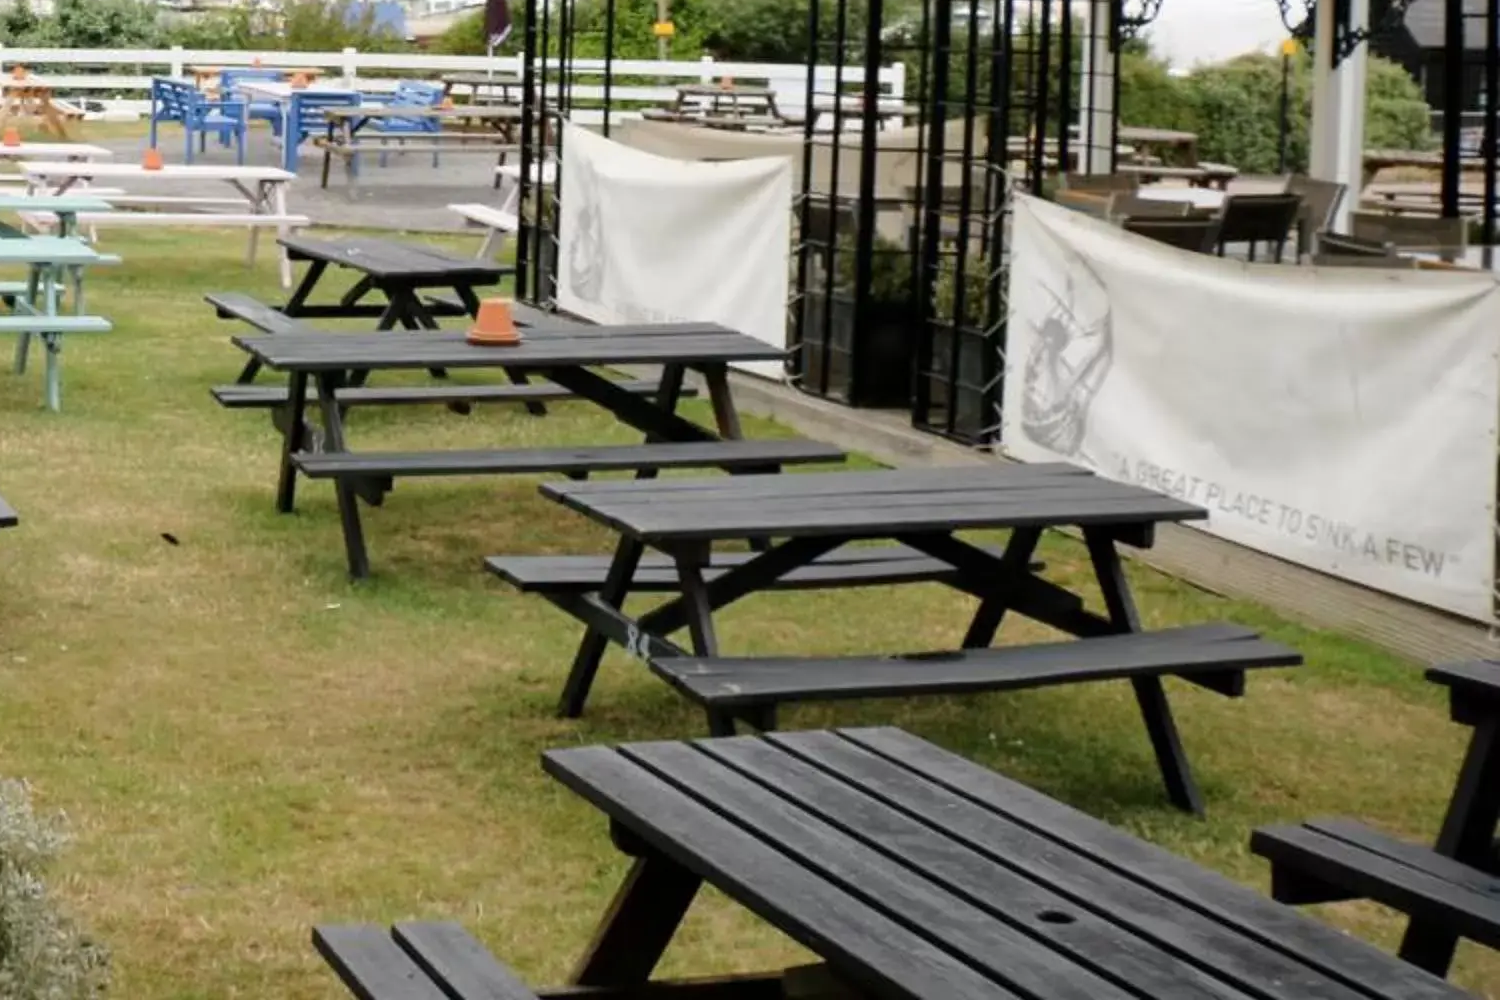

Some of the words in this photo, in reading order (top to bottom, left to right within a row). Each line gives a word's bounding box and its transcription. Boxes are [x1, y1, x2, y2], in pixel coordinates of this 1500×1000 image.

[1135, 459, 1204, 500] GREAT
[1205, 482, 1274, 525] PLACE
[1276, 503, 1303, 534] TO
[1362, 532, 1379, 561] A
